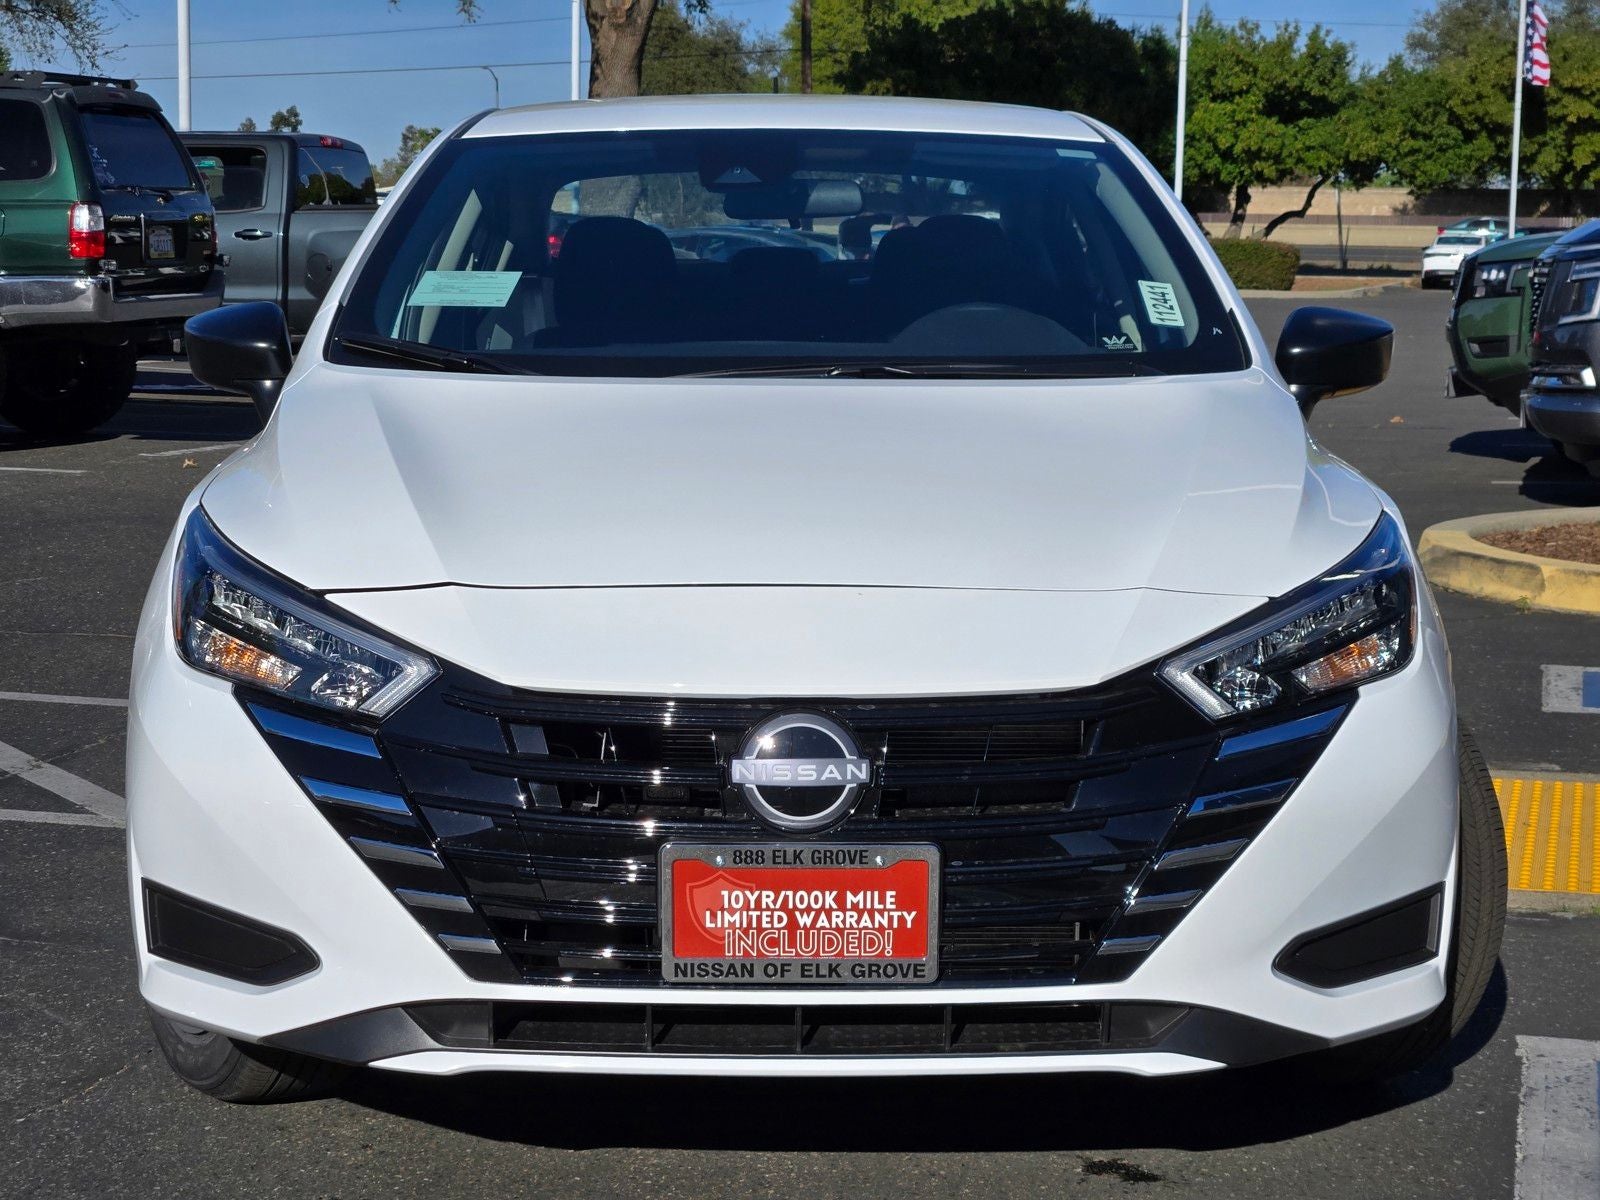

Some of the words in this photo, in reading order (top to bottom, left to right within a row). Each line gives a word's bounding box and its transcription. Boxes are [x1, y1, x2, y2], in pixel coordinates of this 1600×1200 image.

[1145, 285, 1178, 322] 112441
[736, 763, 867, 781] NISSAN
[733, 849, 766, 865] 888
[772, 849, 805, 865] ELK
[811, 849, 869, 865] GROVE
[721, 890, 838, 910] 10YR/100K
[846, 890, 897, 909] MILE
[705, 911, 788, 929] LIMITED
[795, 911, 918, 929] WARRANTY
[725, 929, 894, 956] INCLUDED!
[673, 962, 755, 978] NISSAN
[763, 962, 792, 979] OF
[800, 962, 842, 978] ELK
[850, 962, 926, 979] GROVE
